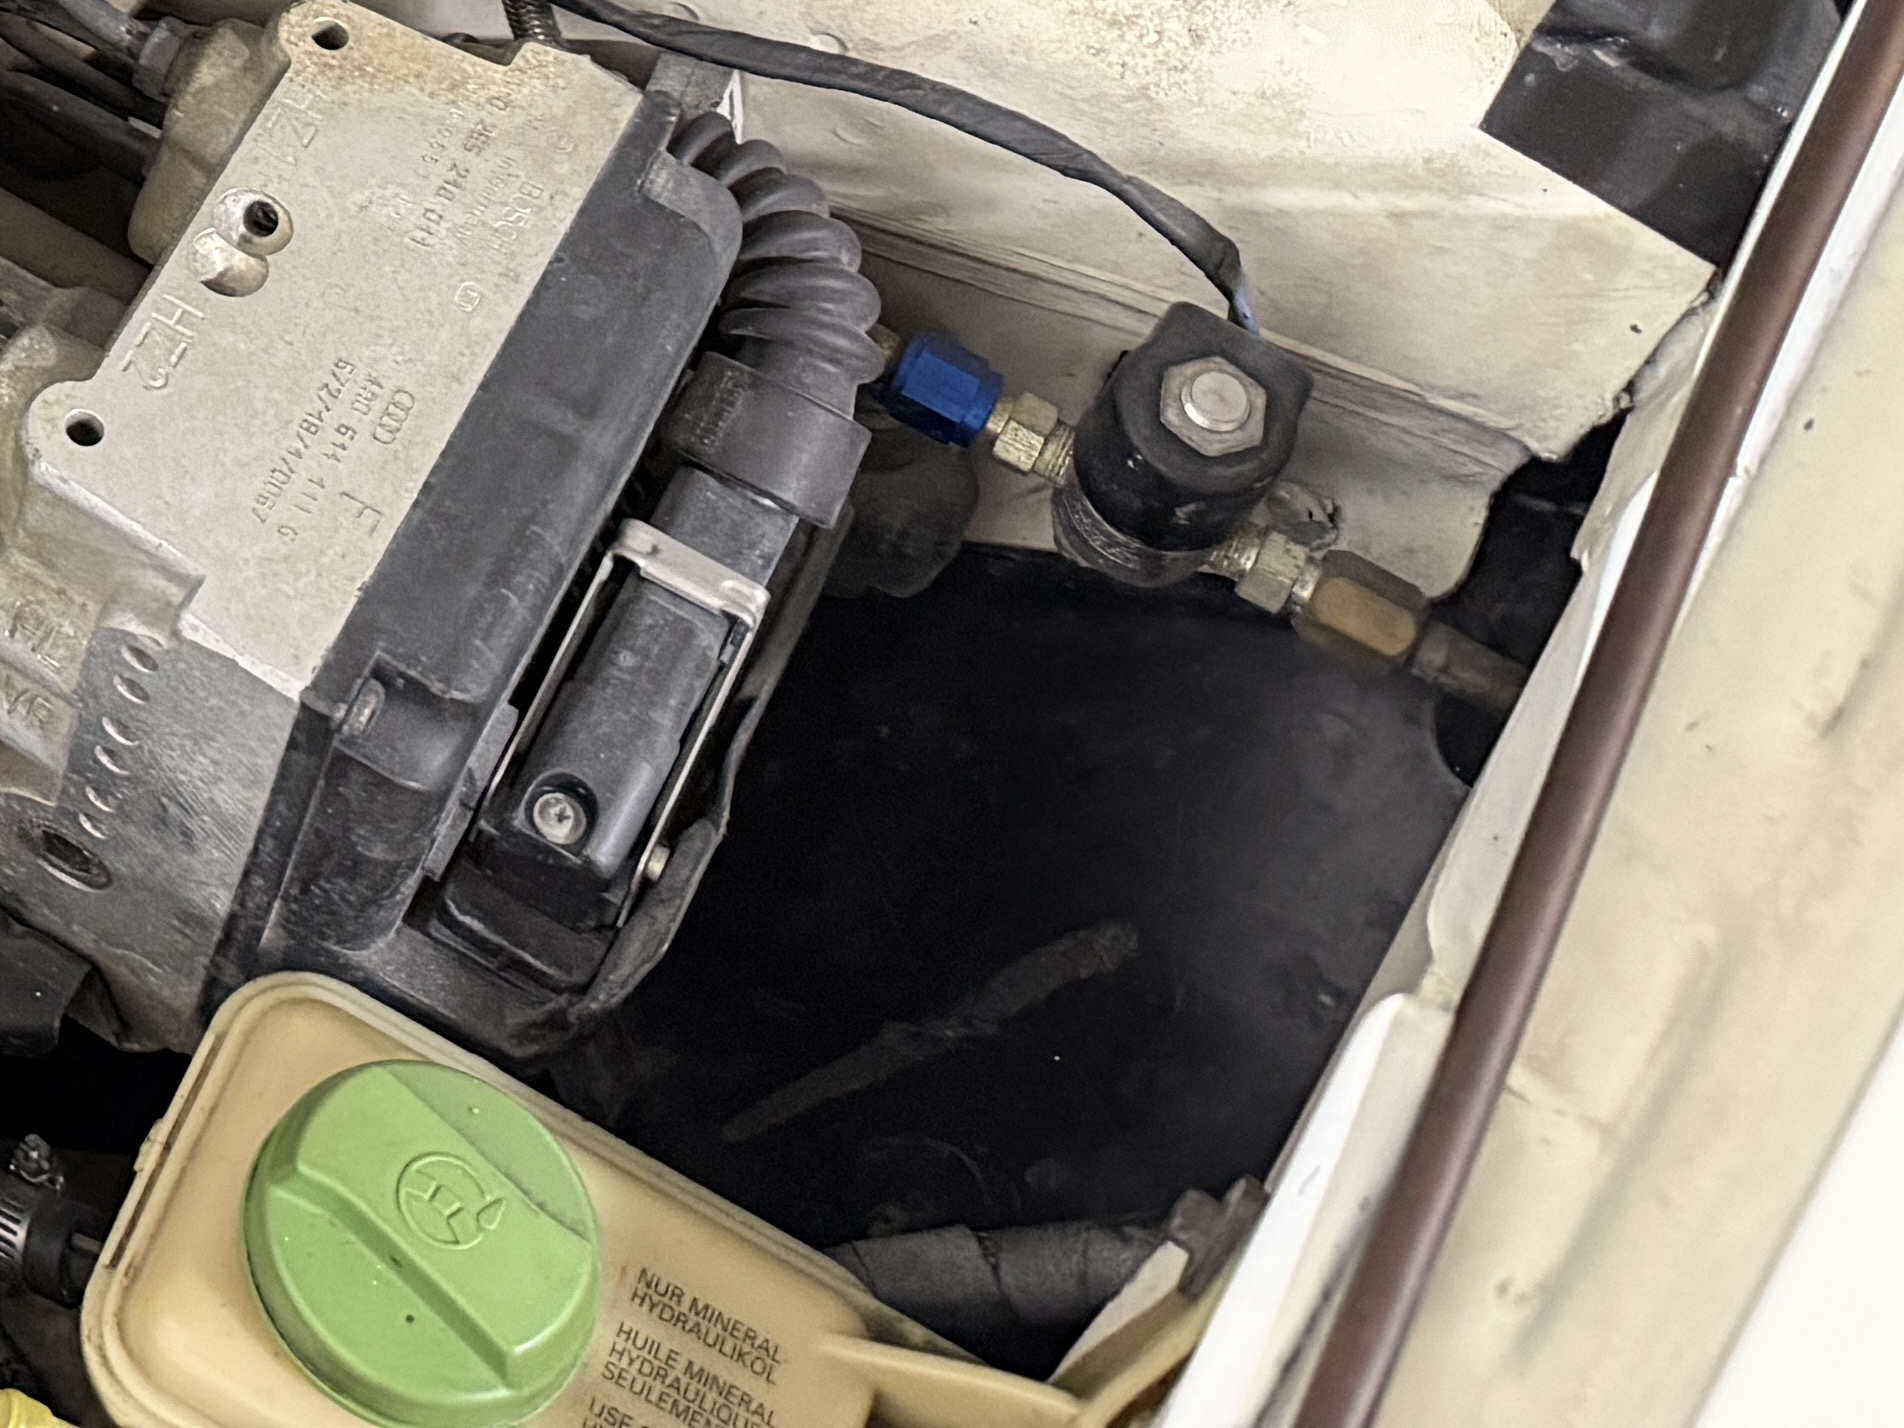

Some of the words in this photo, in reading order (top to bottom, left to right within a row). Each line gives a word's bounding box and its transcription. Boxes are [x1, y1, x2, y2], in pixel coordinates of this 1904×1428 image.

[492, 181, 543, 255] BOSCH
[121, 293, 206, 391] HZ2
[322, 423, 358, 463] 614
[637, 1267, 686, 1304] NUR
[688, 1296, 782, 1365] MINERAL
[616, 1321, 680, 1369] HUILE
[682, 1360, 777, 1428] MINERAL
